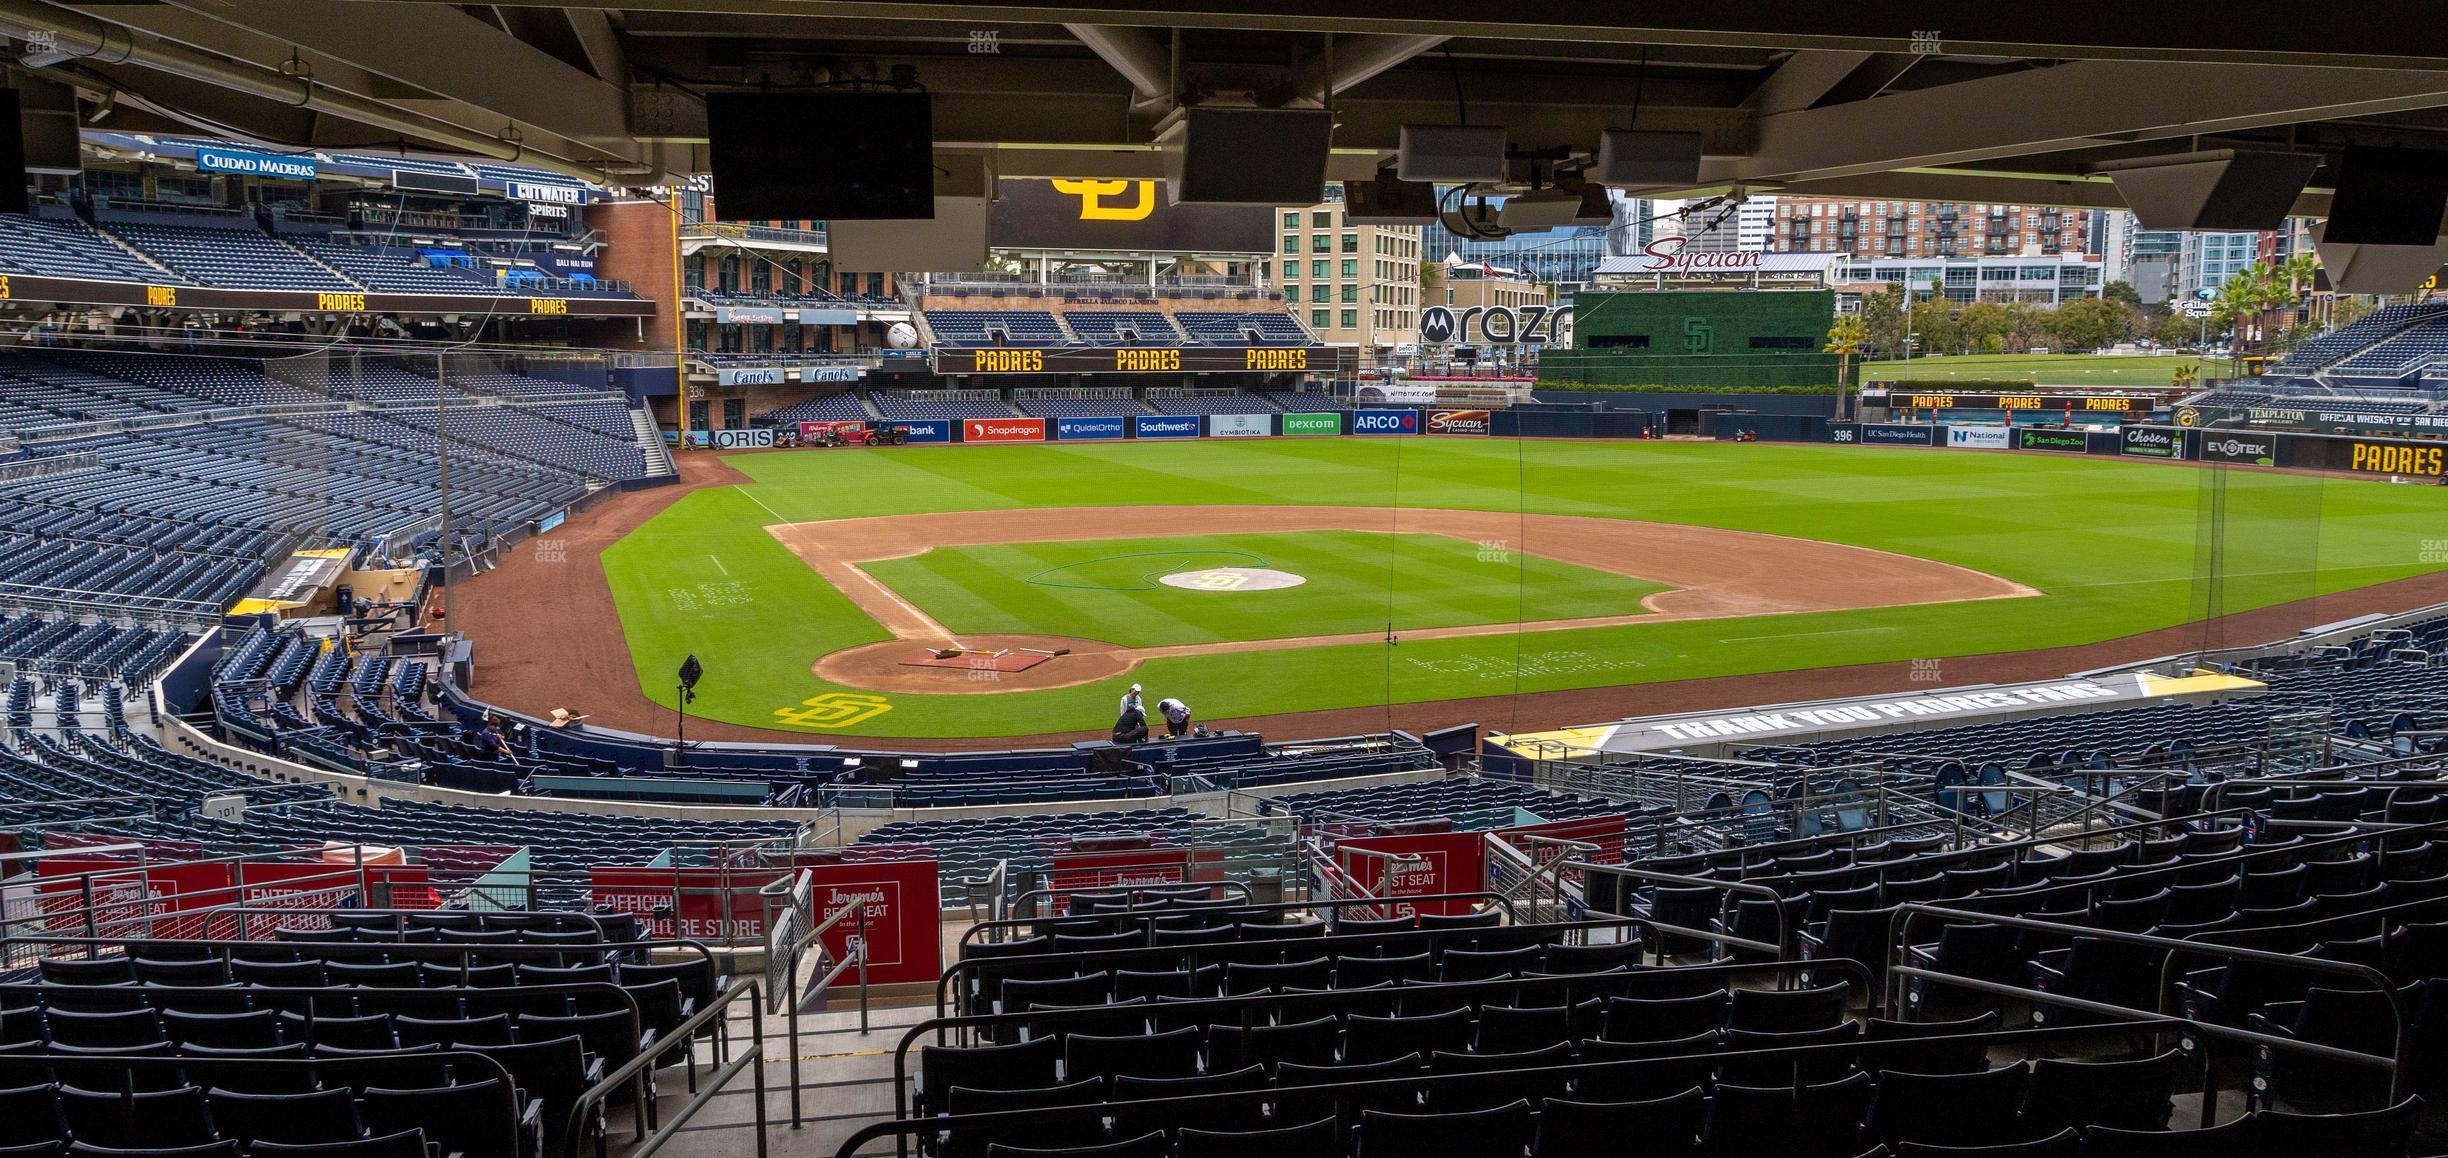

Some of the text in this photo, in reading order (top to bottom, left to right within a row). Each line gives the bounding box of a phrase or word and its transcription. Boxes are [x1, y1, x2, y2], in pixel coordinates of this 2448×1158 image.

[517, 184, 579, 203] CUTWATER
[528, 203, 567, 218] SPIRITS
[1642, 236, 1762, 279] Sycuan
[147, 286, 176, 306] PADRES
[318, 293, 365, 311] PADRES
[531, 299, 567, 314] PADRES
[1459, 305, 1573, 343] razr
[975, 349, 1306, 371] PADRES PADRES PADRES
[2086, 398, 2130, 411] PADRES
[1356, 416, 1400, 429] ARCO
[1430, 412, 1483, 433] Sycuan
[2250, 410, 2305, 421] TEMPLETON
[2319, 413, 2356, 423] OFFICIAL
[2357, 415, 2394, 425] WHISKEY
[2415, 417, 2431, 426] SAN
[987, 425, 1040, 437] Snapdragon
[1073, 423, 1121, 433] QuidelOrtho
[1140, 421, 1188, 432] Southwest
[718, 430, 771, 447] ORIS
[1834, 430, 1852, 441] 396
[1878, 430, 1889, 438] San
[1889, 431, 1906, 439] Diego
[1906, 431, 1926, 439] Health
[1969, 431, 2005, 440] National
[2050, 438, 2069, 446] Diego
[2127, 429, 2170, 444] Chosen
[2352, 443, 2443, 476] PADRES
[1650, 683, 2118, 739] THANK YOU PADRES FANS
[217, 806, 235, 818] 101
[1408, 873, 1436, 886] SEAT
[828, 887, 885, 905] Jerome's
